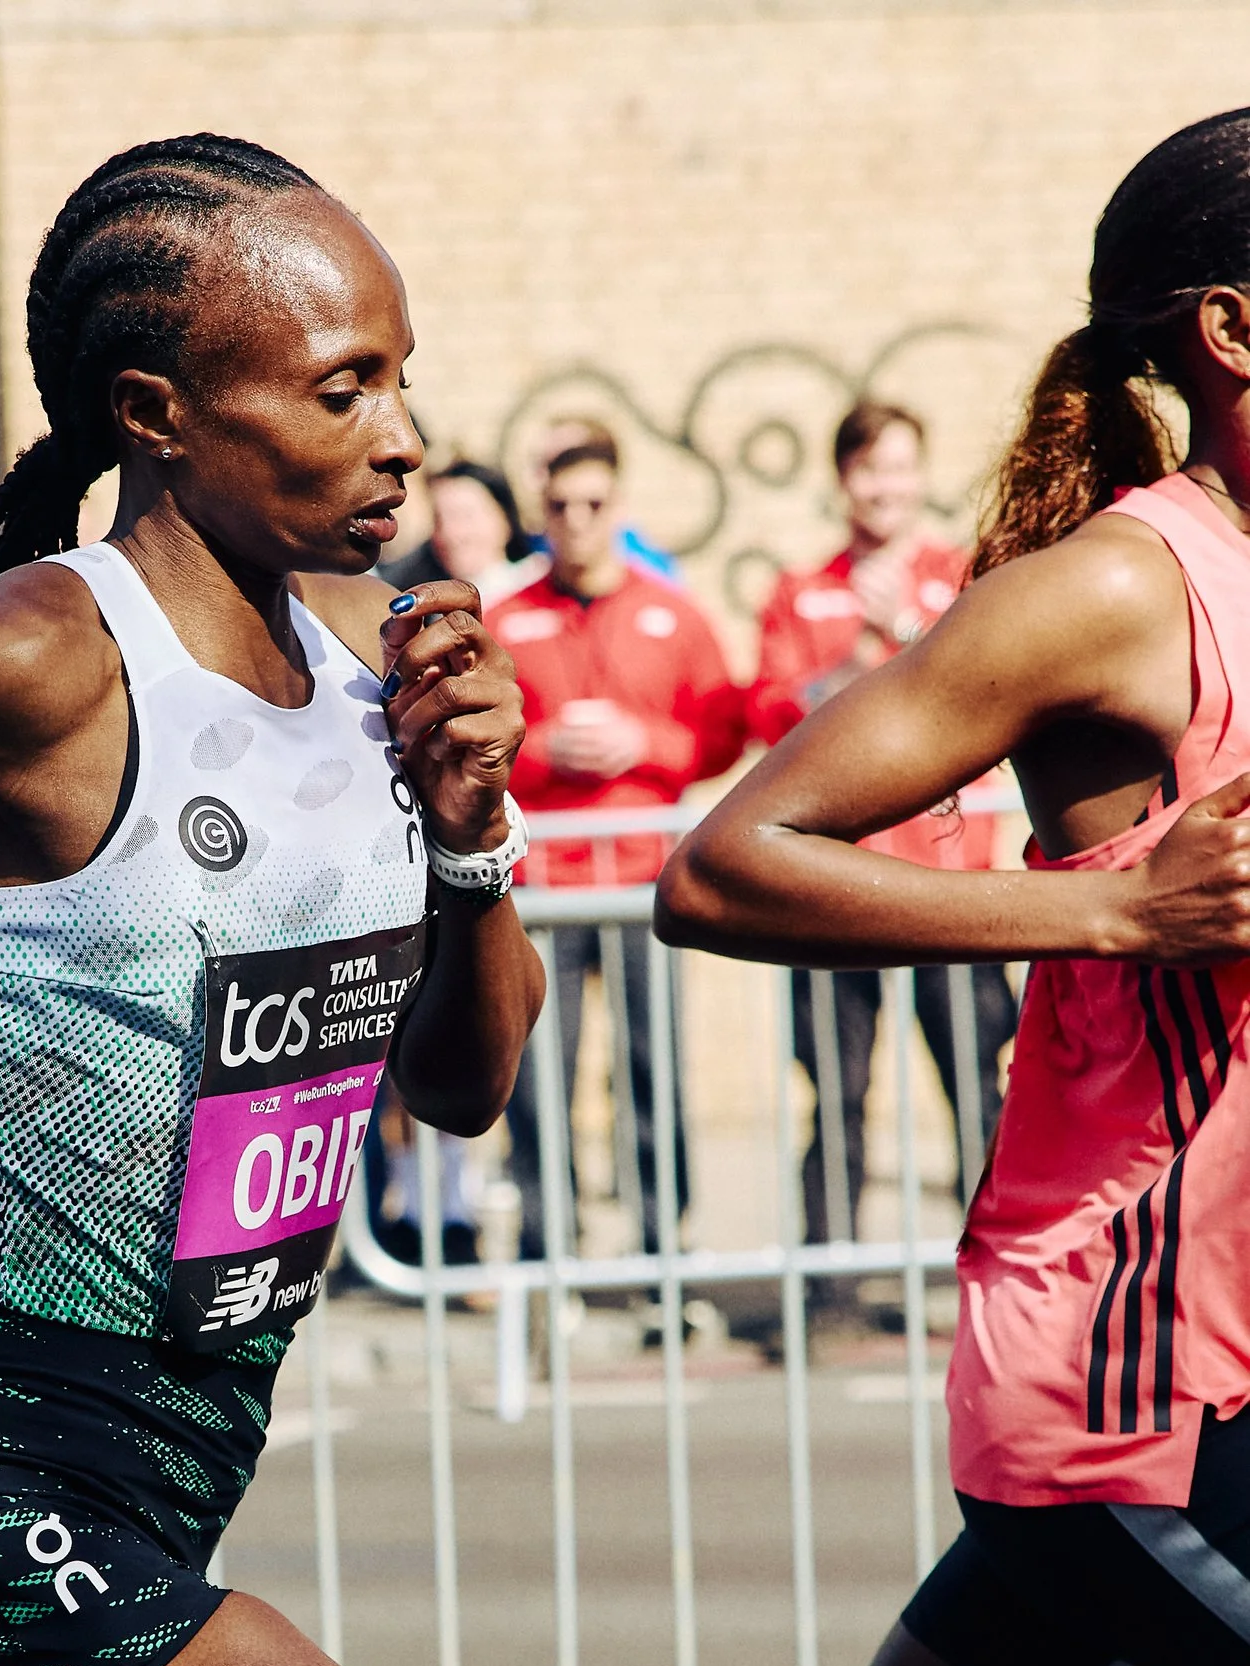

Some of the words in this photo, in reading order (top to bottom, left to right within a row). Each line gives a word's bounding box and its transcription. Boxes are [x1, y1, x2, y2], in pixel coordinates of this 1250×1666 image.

[330, 954, 377, 985] TATA
[220, 981, 315, 1067] tcs
[318, 1011, 397, 1050] SERVICES
[293, 1076, 365, 1105] #WeRunTogether
[273, 1279, 310, 1312] new
